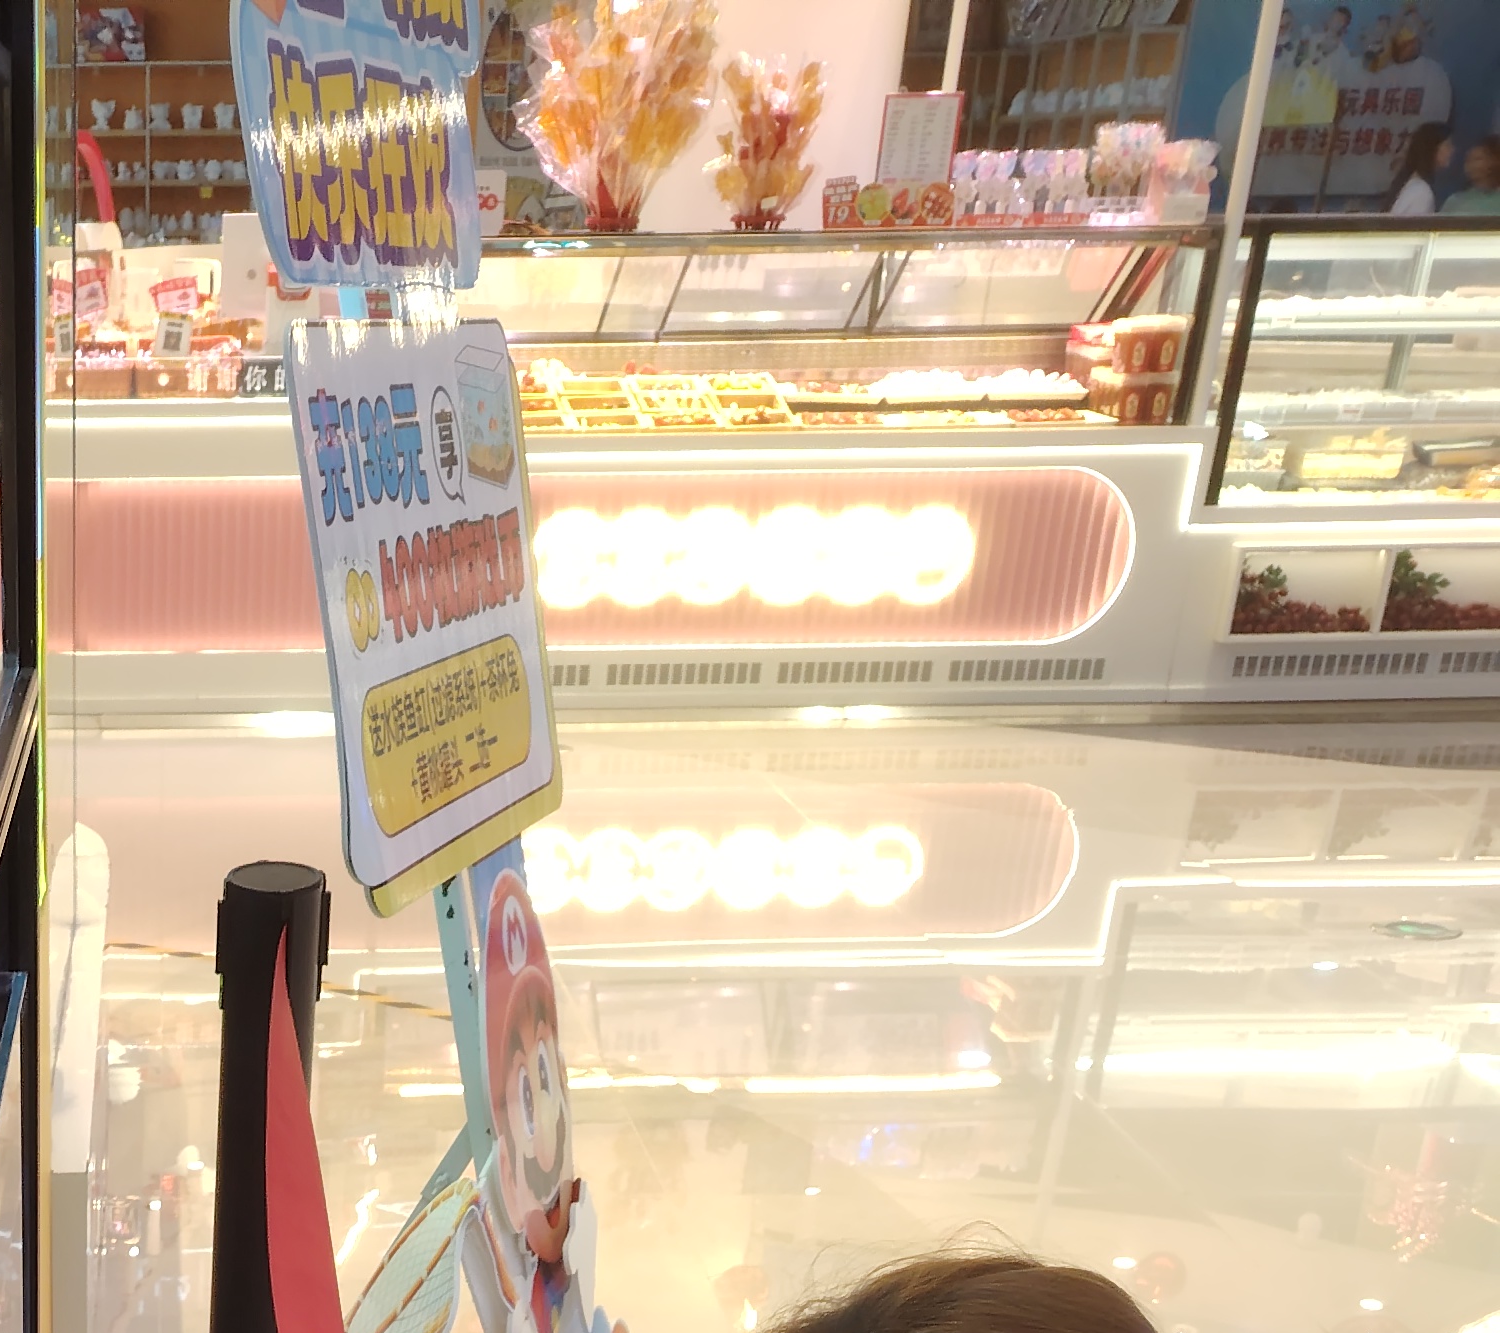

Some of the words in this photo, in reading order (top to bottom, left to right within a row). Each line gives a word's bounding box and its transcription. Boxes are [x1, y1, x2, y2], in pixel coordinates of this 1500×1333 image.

[268, 40, 458, 266] 快乐狂欢
[308, 383, 430, 526] 充138元
[379, 507, 525, 643] 400枚游戏币
